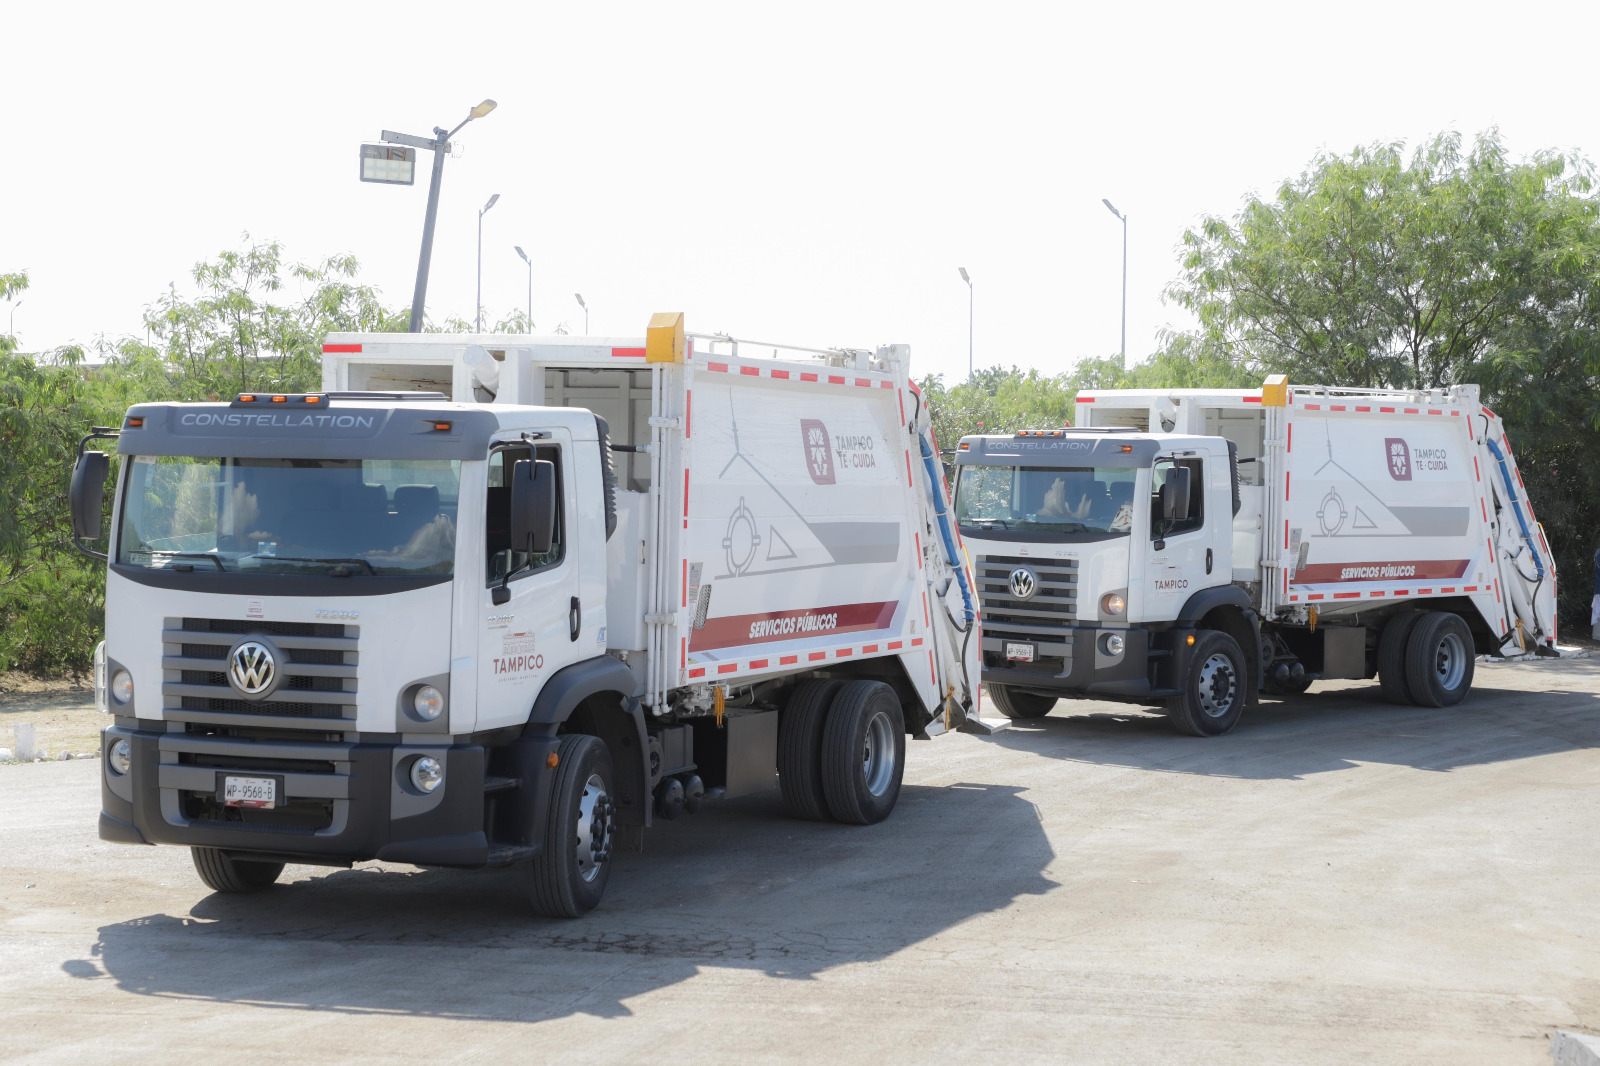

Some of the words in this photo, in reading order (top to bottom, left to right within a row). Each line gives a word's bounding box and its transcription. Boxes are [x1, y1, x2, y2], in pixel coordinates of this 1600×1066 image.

[181, 413, 374, 428] CONSTELLATION
[835, 435, 874, 450] TAMPICO
[987, 442, 1090, 450] CONSTELLATION
[852, 453, 876, 468] CUIDA
[1414, 448, 1447, 459] TAMPICO
[1416, 460, 1424, 470] TE
[1427, 460, 1448, 470] CUIDA
[1341, 566, 1380, 579] SERVICIOS
[1380, 564, 1415, 577] PÚBLICOS
[1155, 579, 1188, 590] TAMPICO
[749, 616, 796, 639] SERVICIOS
[796, 612, 838, 633] PÚBLICOS
[493, 654, 544, 675] TAMPICO
[227, 783, 273, 800] WP-9568-B
